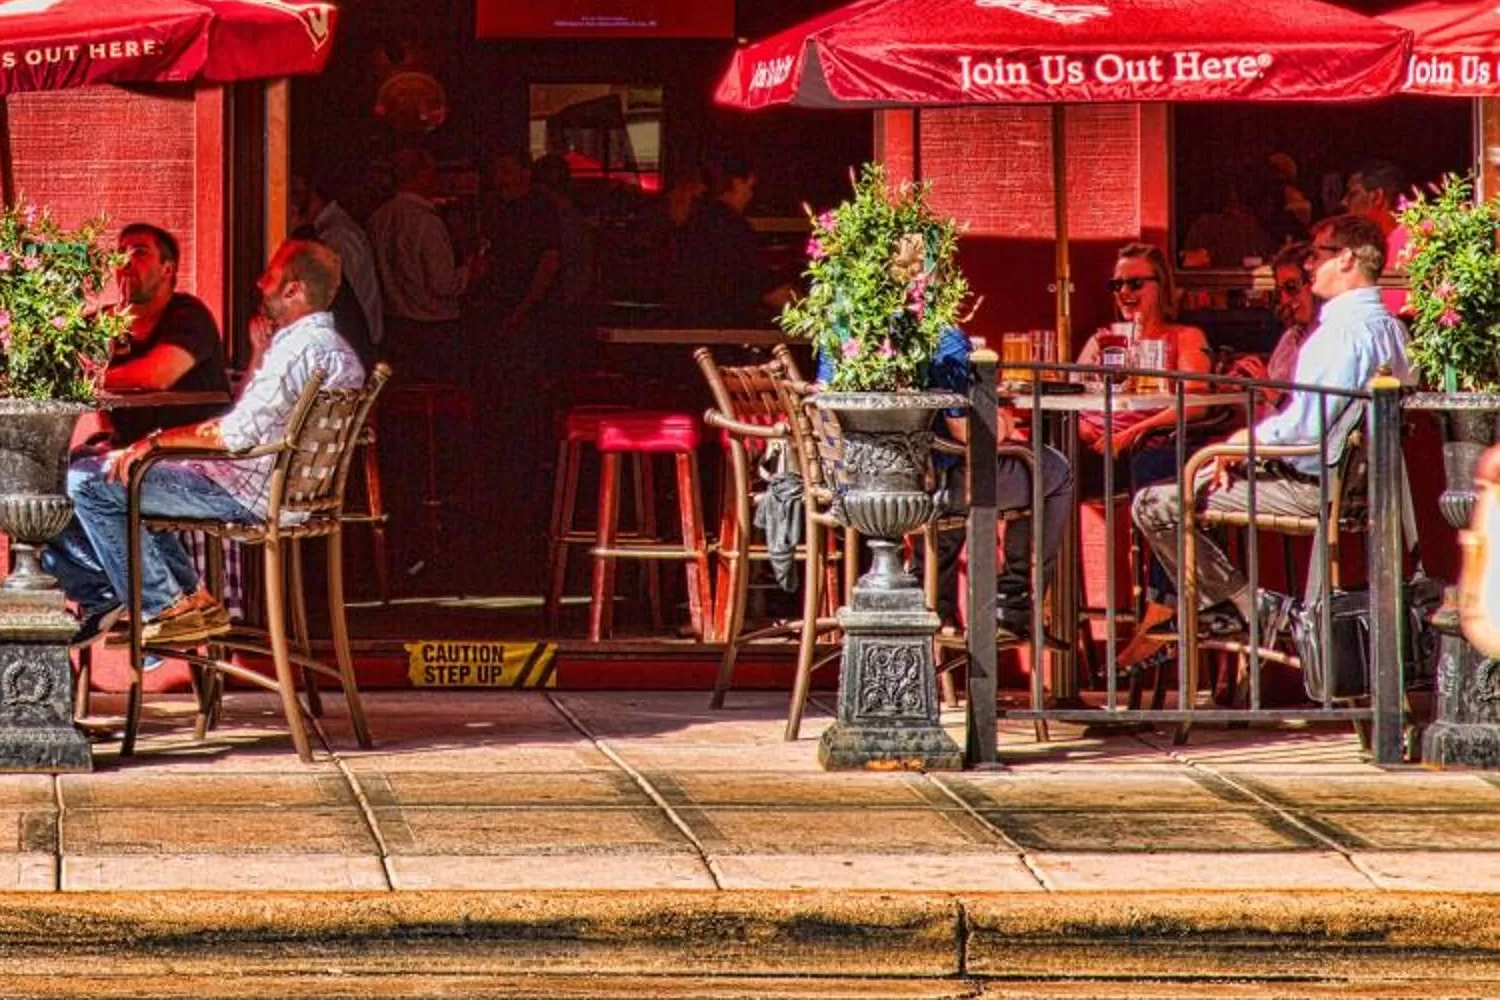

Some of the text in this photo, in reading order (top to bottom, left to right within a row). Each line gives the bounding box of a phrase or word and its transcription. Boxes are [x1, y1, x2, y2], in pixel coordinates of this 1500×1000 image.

[25, 46, 80, 65] OUT
[957, 55, 1030, 91] Join
[1040, 55, 1085, 85] Us
[1094, 53, 1166, 83] Out
[1402, 54, 1454, 90] Join
[1461, 55, 1490, 85] Us
[422, 644, 504, 663] CAUTION
[424, 665, 502, 684] STEP UP
